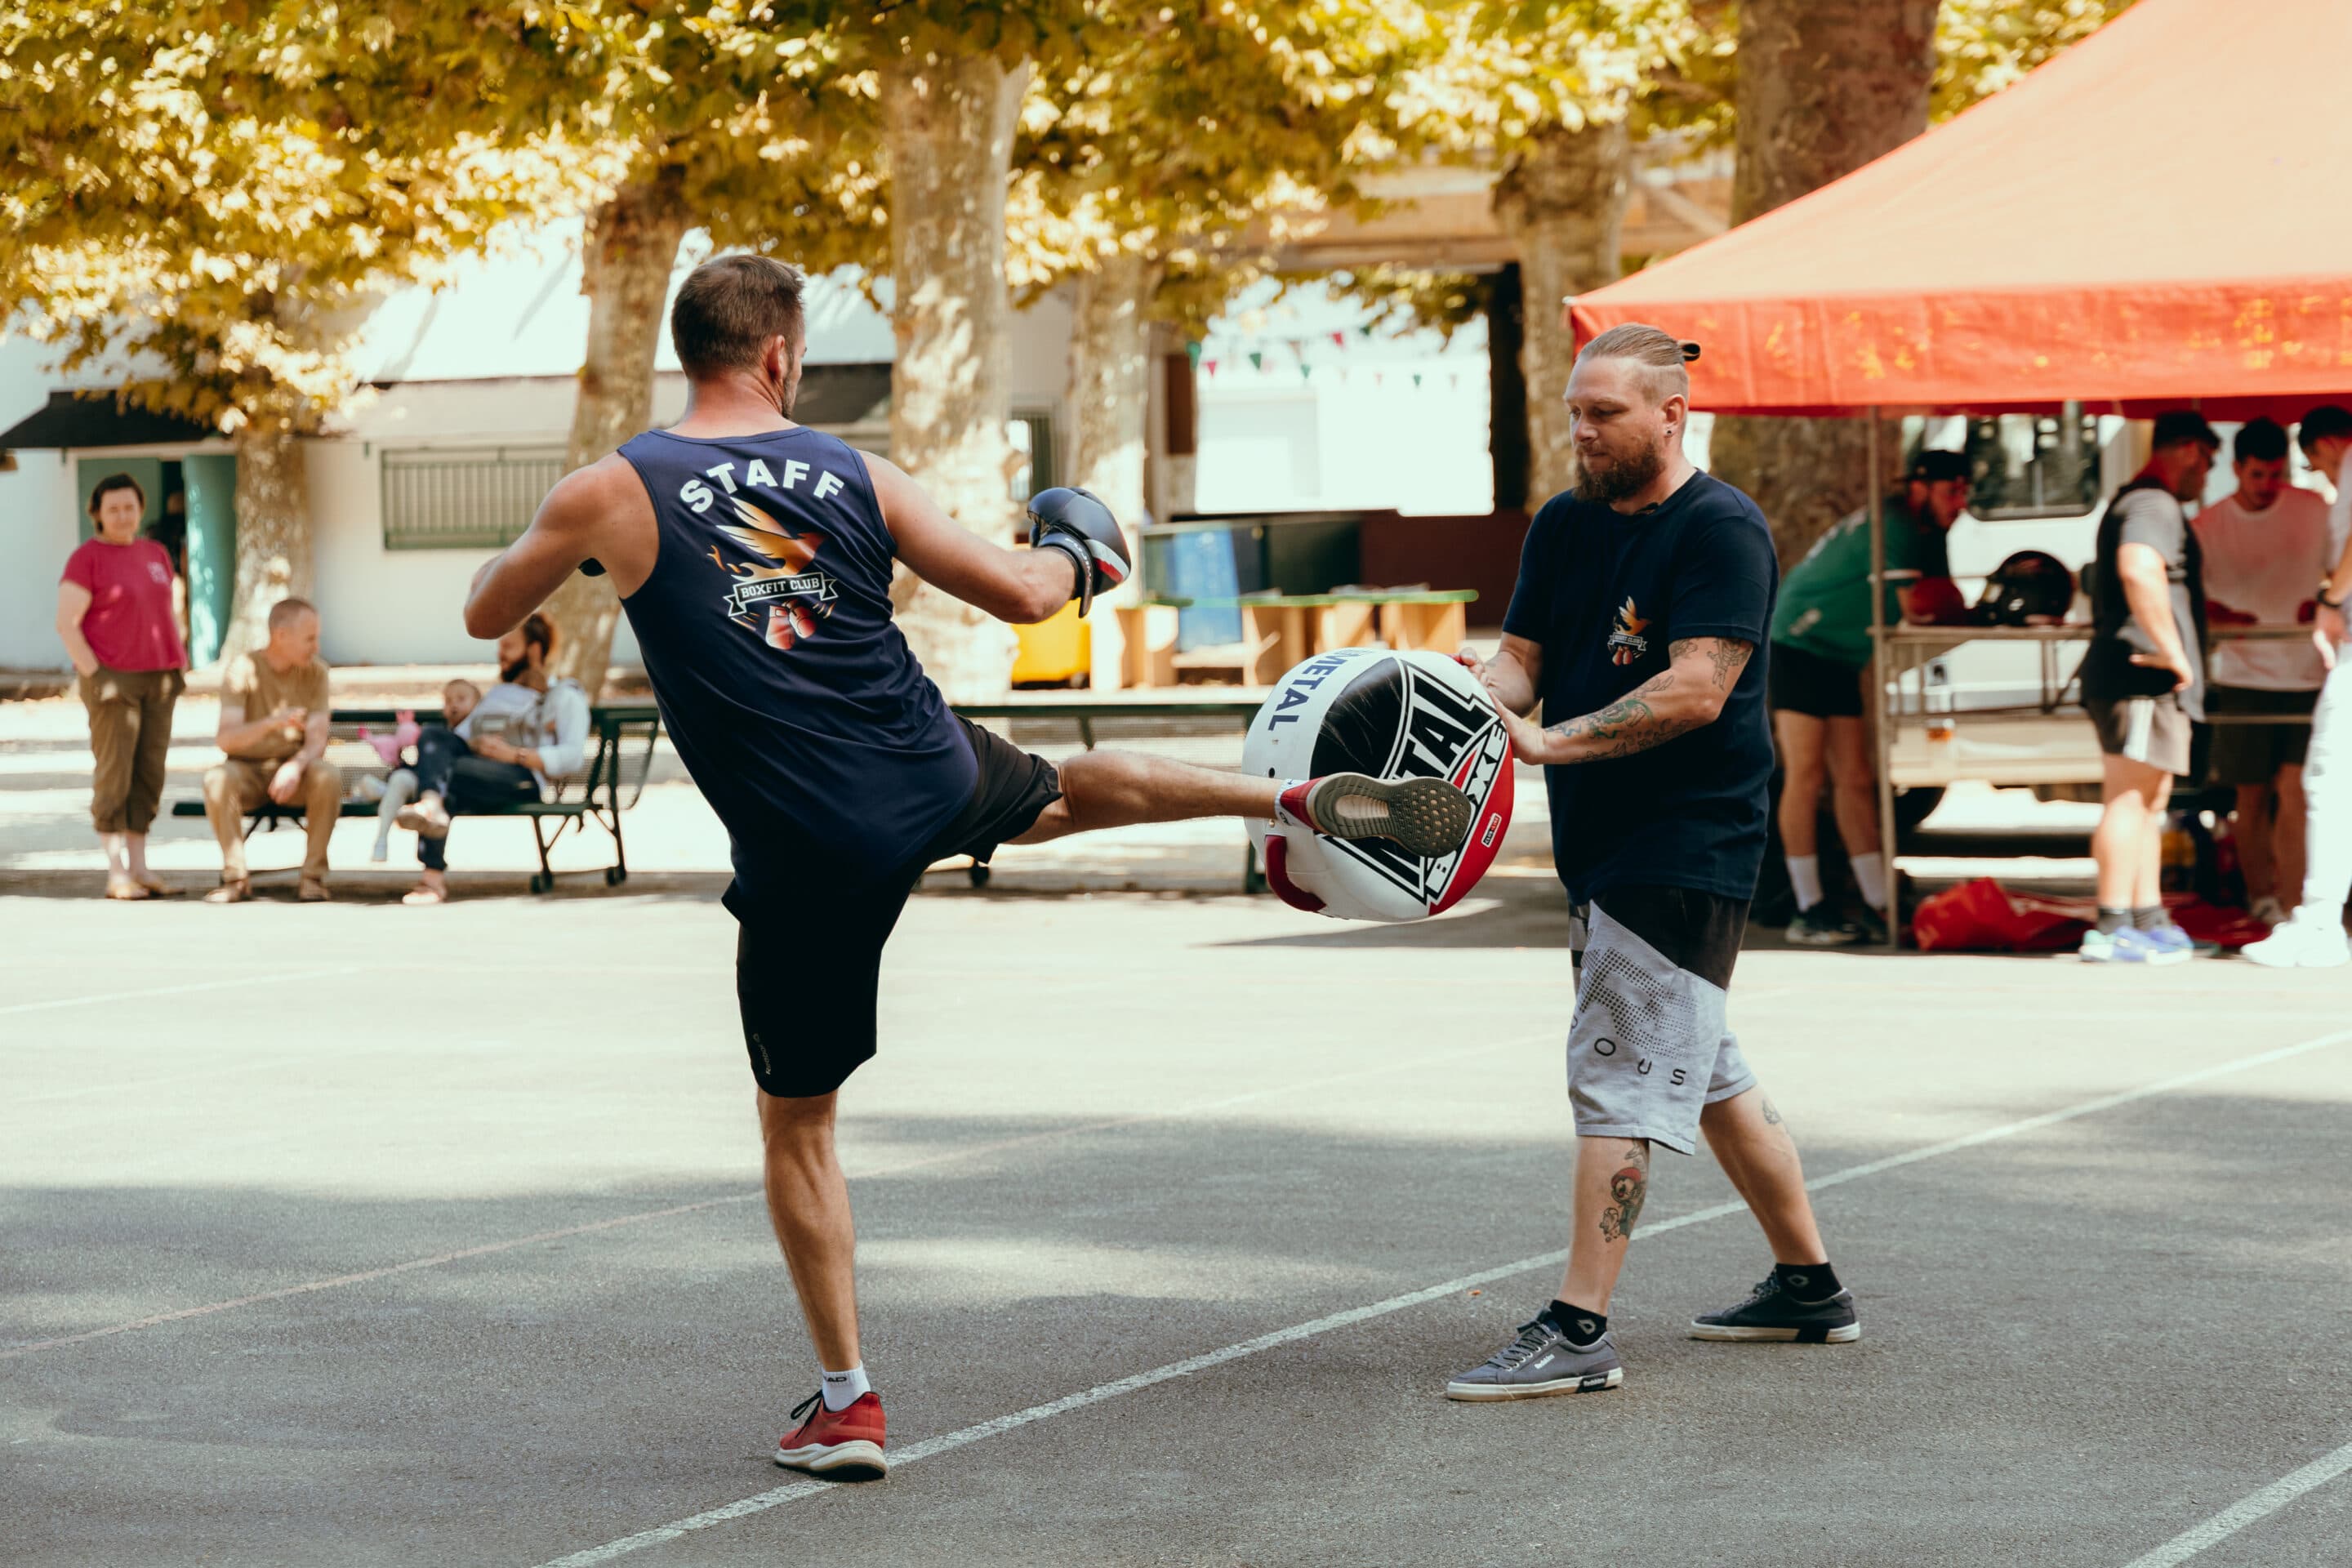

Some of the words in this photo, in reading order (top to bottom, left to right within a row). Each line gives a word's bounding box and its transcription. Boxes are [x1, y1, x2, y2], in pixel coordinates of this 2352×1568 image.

[679, 458, 845, 514] STAFF
[740, 580, 786, 599] BOXFIT
[789, 577, 820, 590] CLUB
[1267, 651, 1360, 731] METAL
[1345, 675, 1494, 889] MTAL
[1424, 724, 1507, 893] BXE
